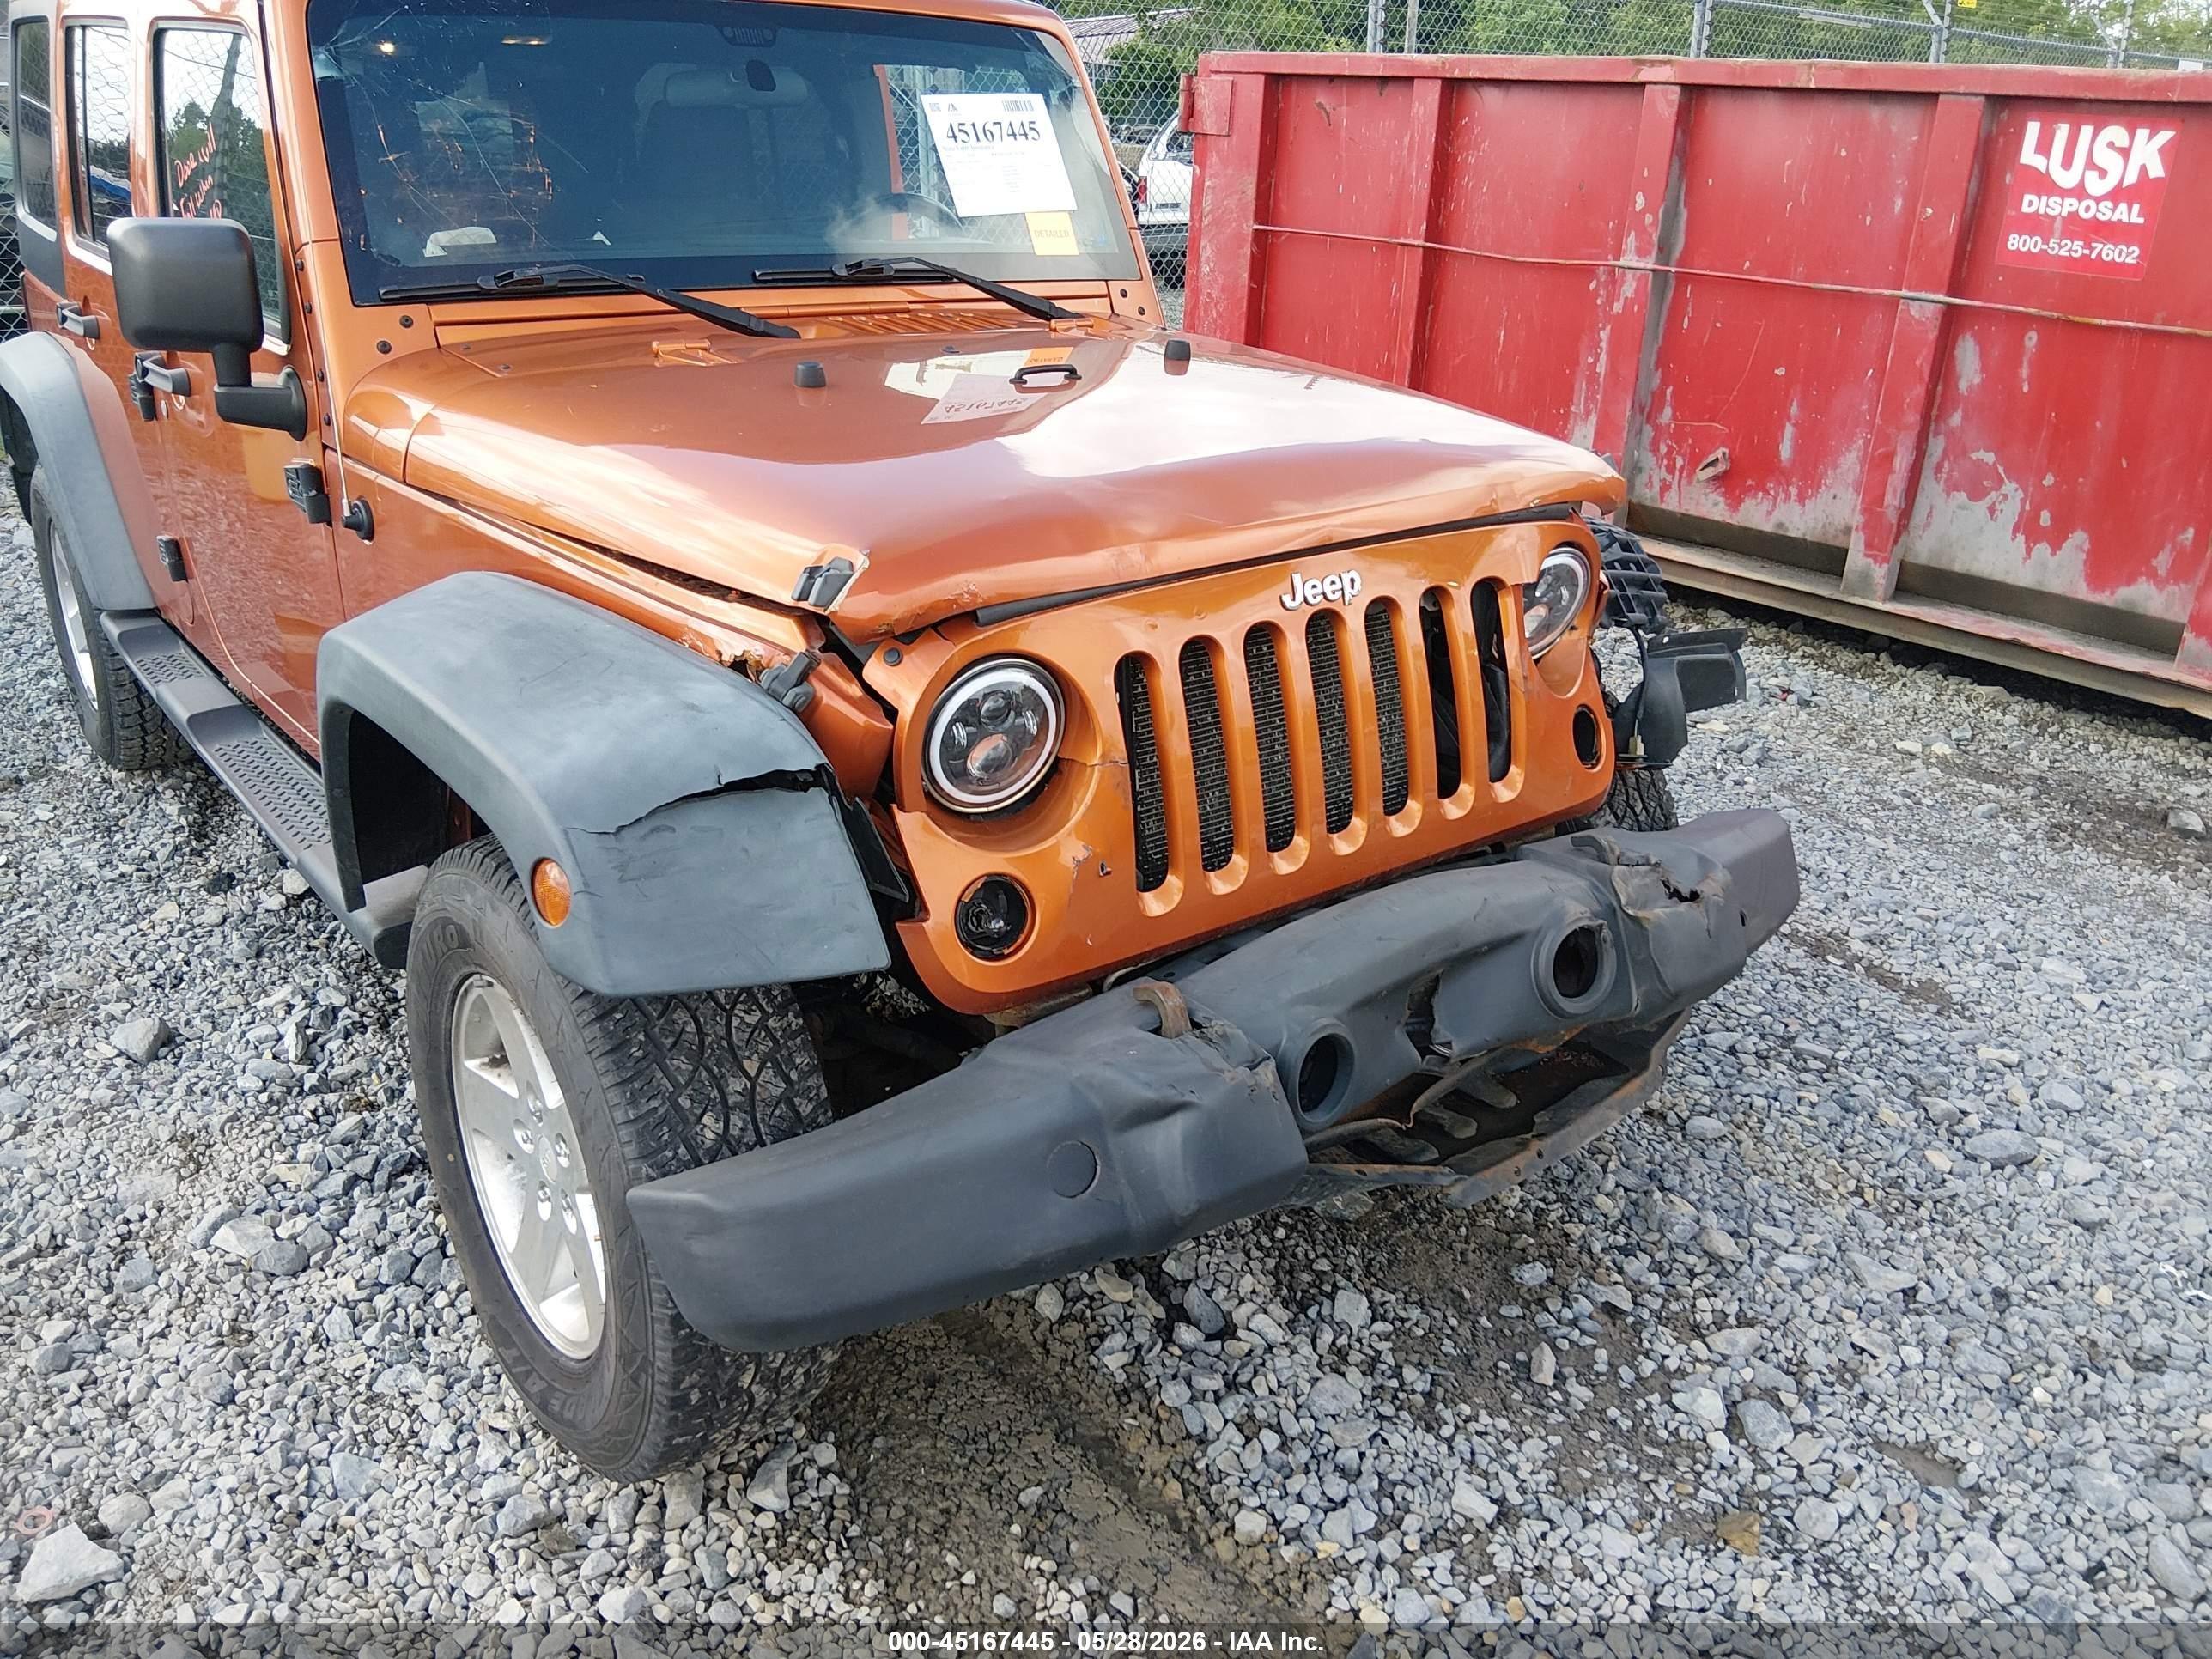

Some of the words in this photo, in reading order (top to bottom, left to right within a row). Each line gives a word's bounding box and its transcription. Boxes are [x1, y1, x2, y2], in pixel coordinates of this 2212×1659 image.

[946, 120, 1041, 143] 45167445
[2020, 121, 2177, 197] LUSK
[2021, 193, 2145, 224] DISPOSAL
[2007, 234, 2140, 264] 800-525-7602
[1279, 569, 1362, 611] Jeep
